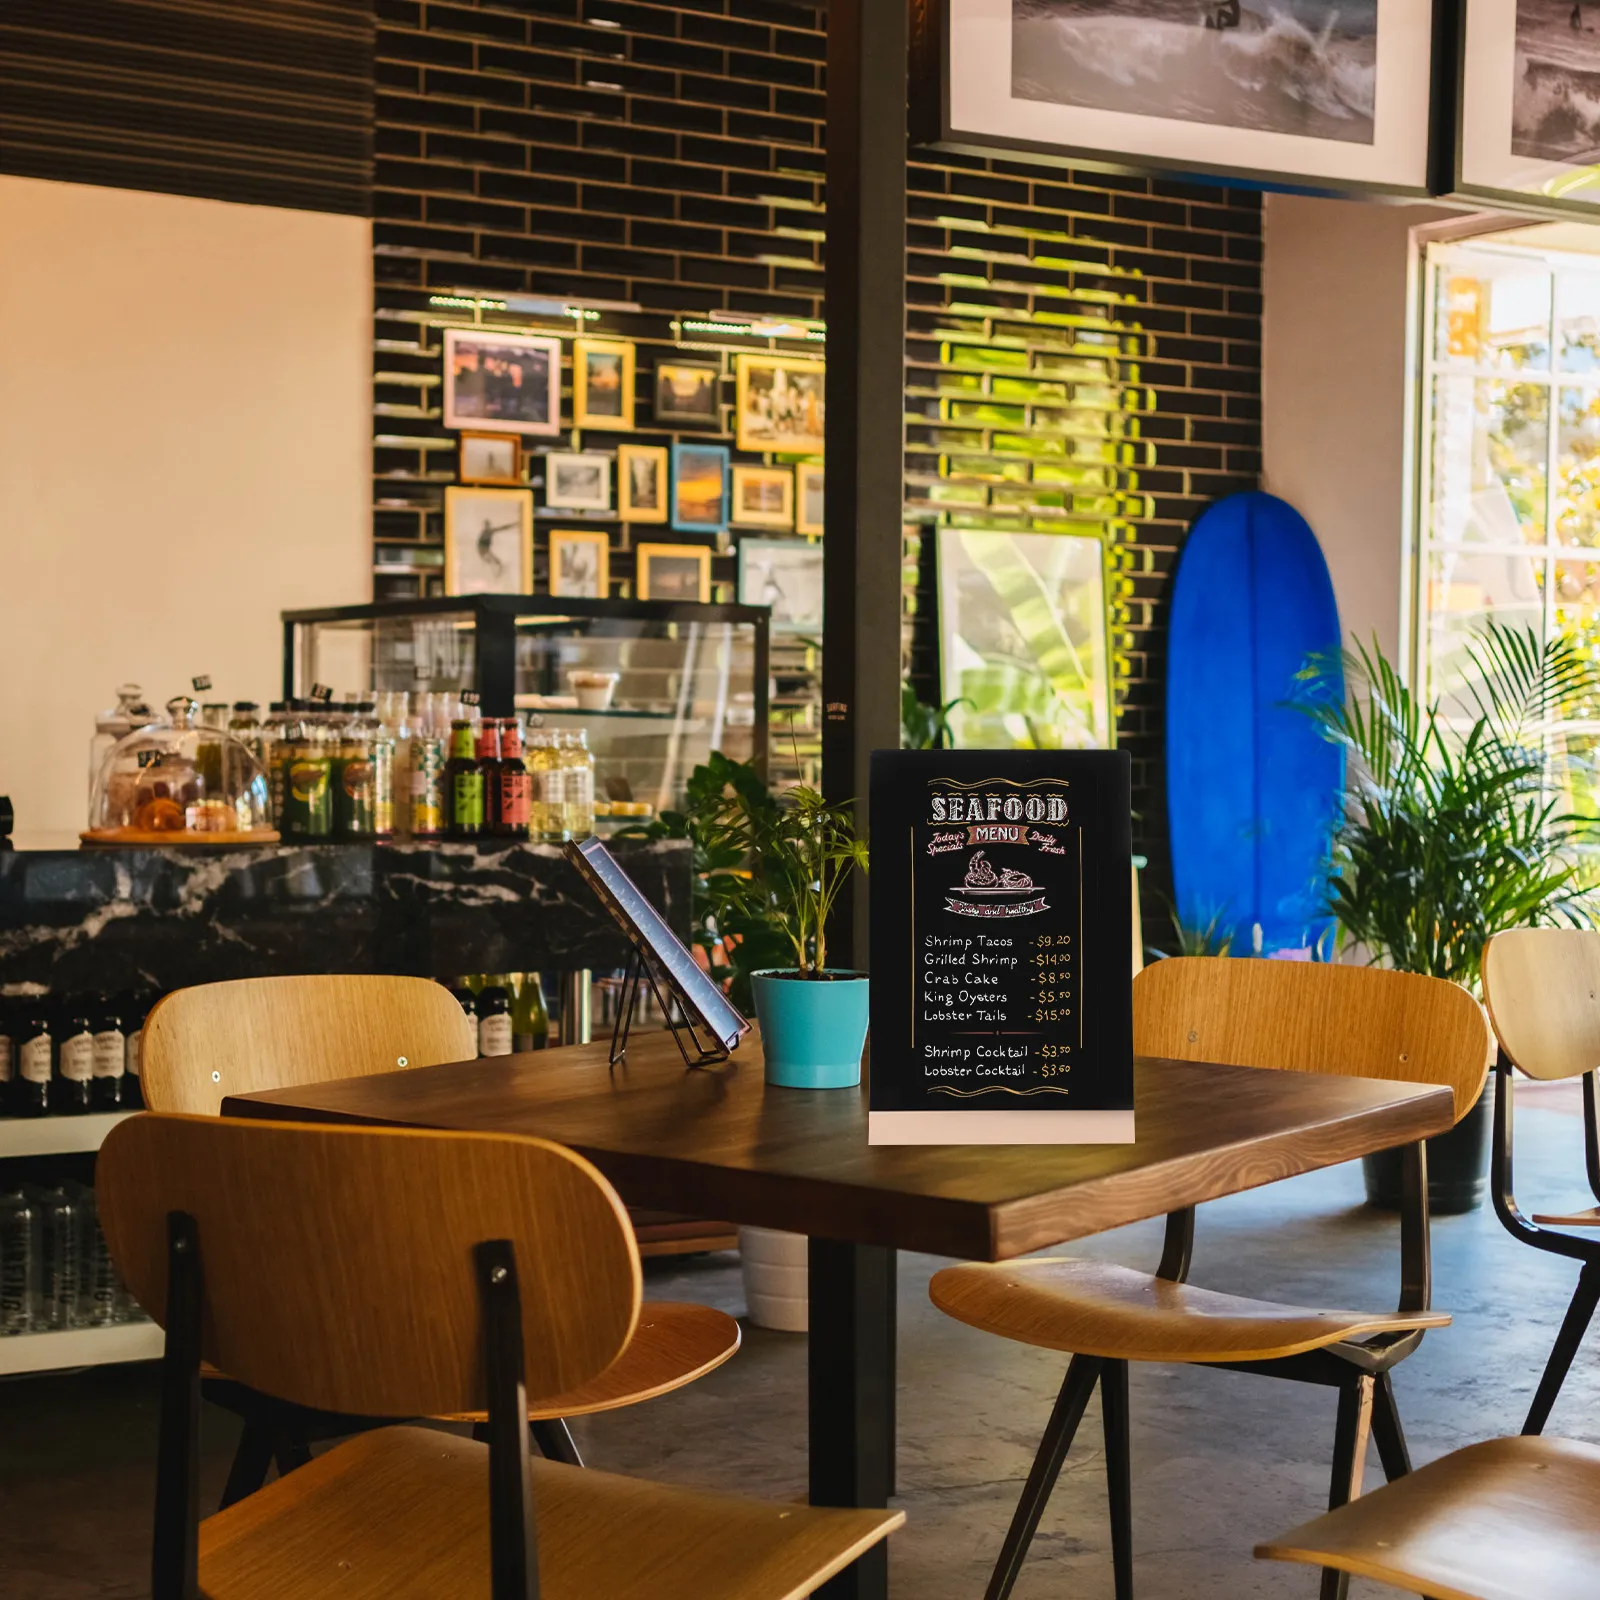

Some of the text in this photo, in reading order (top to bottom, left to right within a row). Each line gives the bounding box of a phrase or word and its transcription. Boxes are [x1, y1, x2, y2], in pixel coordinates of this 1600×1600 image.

[931, 797, 1069, 822] SEAFOOD
[931, 831, 966, 844] Today's
[976, 827, 1020, 842] MENU
[1028, 831, 1057, 846] Daily
[926, 842, 964, 856] Specials
[1038, 843, 1065, 855] Fresh
[984, 905, 1001, 915] and
[924, 935, 973, 950] Shrimp
[977, 935, 1013, 947] Tacos
[924, 953, 966, 965] Grilled
[972, 953, 1018, 969] Shrimp
[924, 971, 959, 984] Crab
[965, 972, 999, 985] Cake
[924, 990, 954, 1007] King
[958, 990, 1008, 1006] Oysters
[924, 1010, 973, 1021] Lobster
[976, 1010, 1007, 1021] Tails
[924, 1045, 970, 1060] Shrimp
[976, 1045, 1028, 1058] Cocktail
[924, 1065, 973, 1077] Lobster
[975, 1064, 1025, 1077] Cocktail
